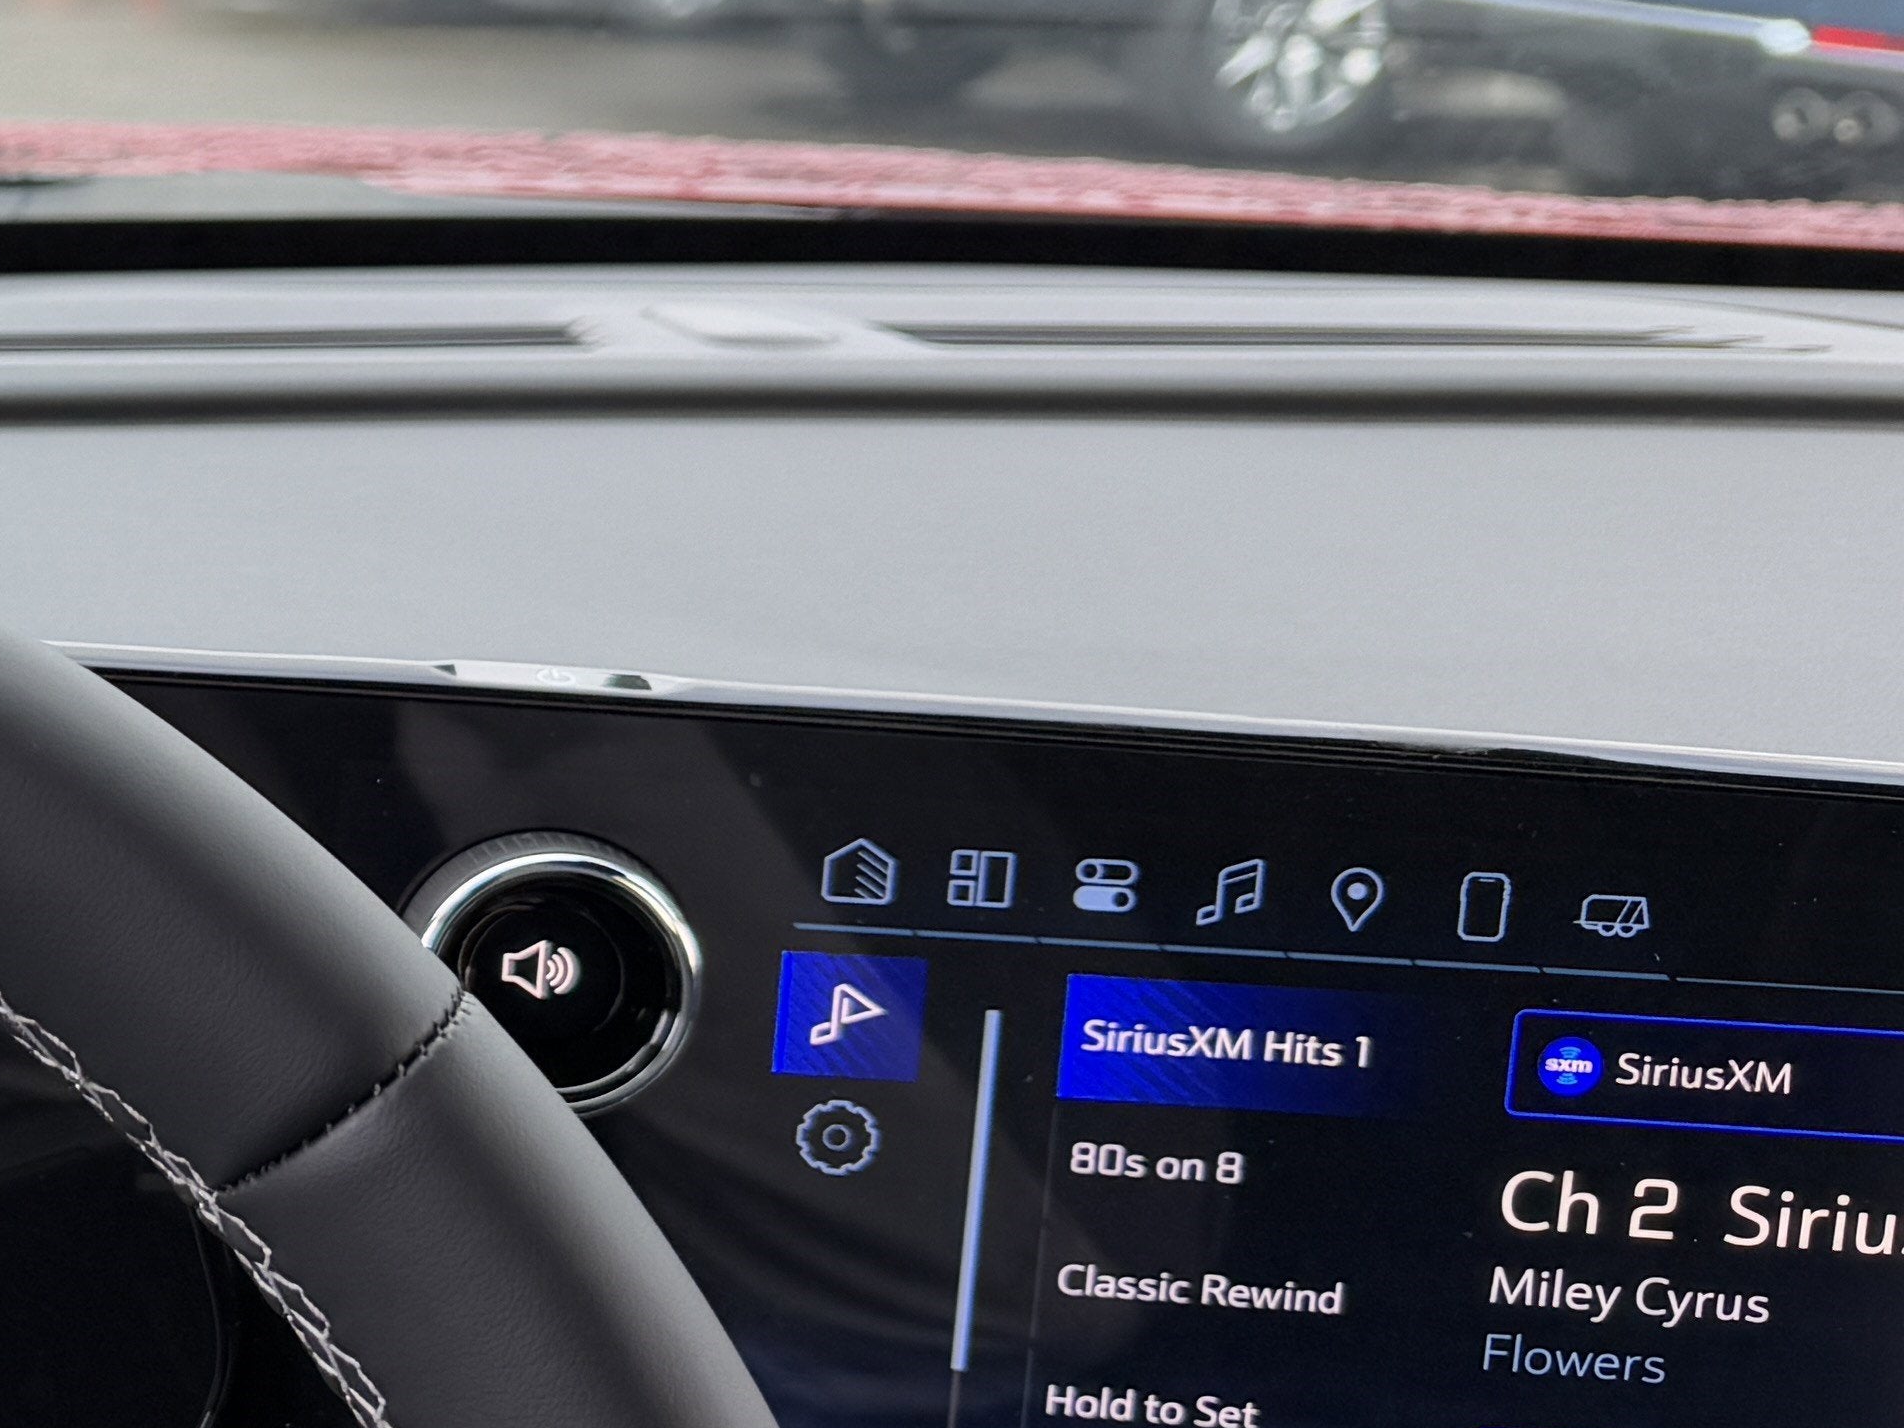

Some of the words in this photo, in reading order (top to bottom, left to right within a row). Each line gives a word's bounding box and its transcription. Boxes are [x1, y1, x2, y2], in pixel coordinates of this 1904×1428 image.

[1082, 1018, 1253, 1063] SiriusXM
[1263, 1030, 1344, 1067] Hits
[1355, 1035, 1370, 1068] 1
[1615, 1052, 1792, 1095] SiriusXM
[1070, 1141, 1147, 1178] 80s
[1155, 1156, 1206, 1182] on
[1215, 1151, 1244, 1185] 8
[1501, 1170, 1600, 1235] Ch
[1628, 1178, 1679, 1240] 2
[1722, 1184, 1904, 1256] Siriu
[1057, 1263, 1190, 1304] Classic
[1200, 1273, 1344, 1315] Rewind
[1489, 1265, 1622, 1323] Miley
[1635, 1276, 1770, 1328] Cyrus
[1482, 1333, 1666, 1384] Flowers
[1045, 1384, 1137, 1422] Hold
[1143, 1394, 1186, 1426] to
